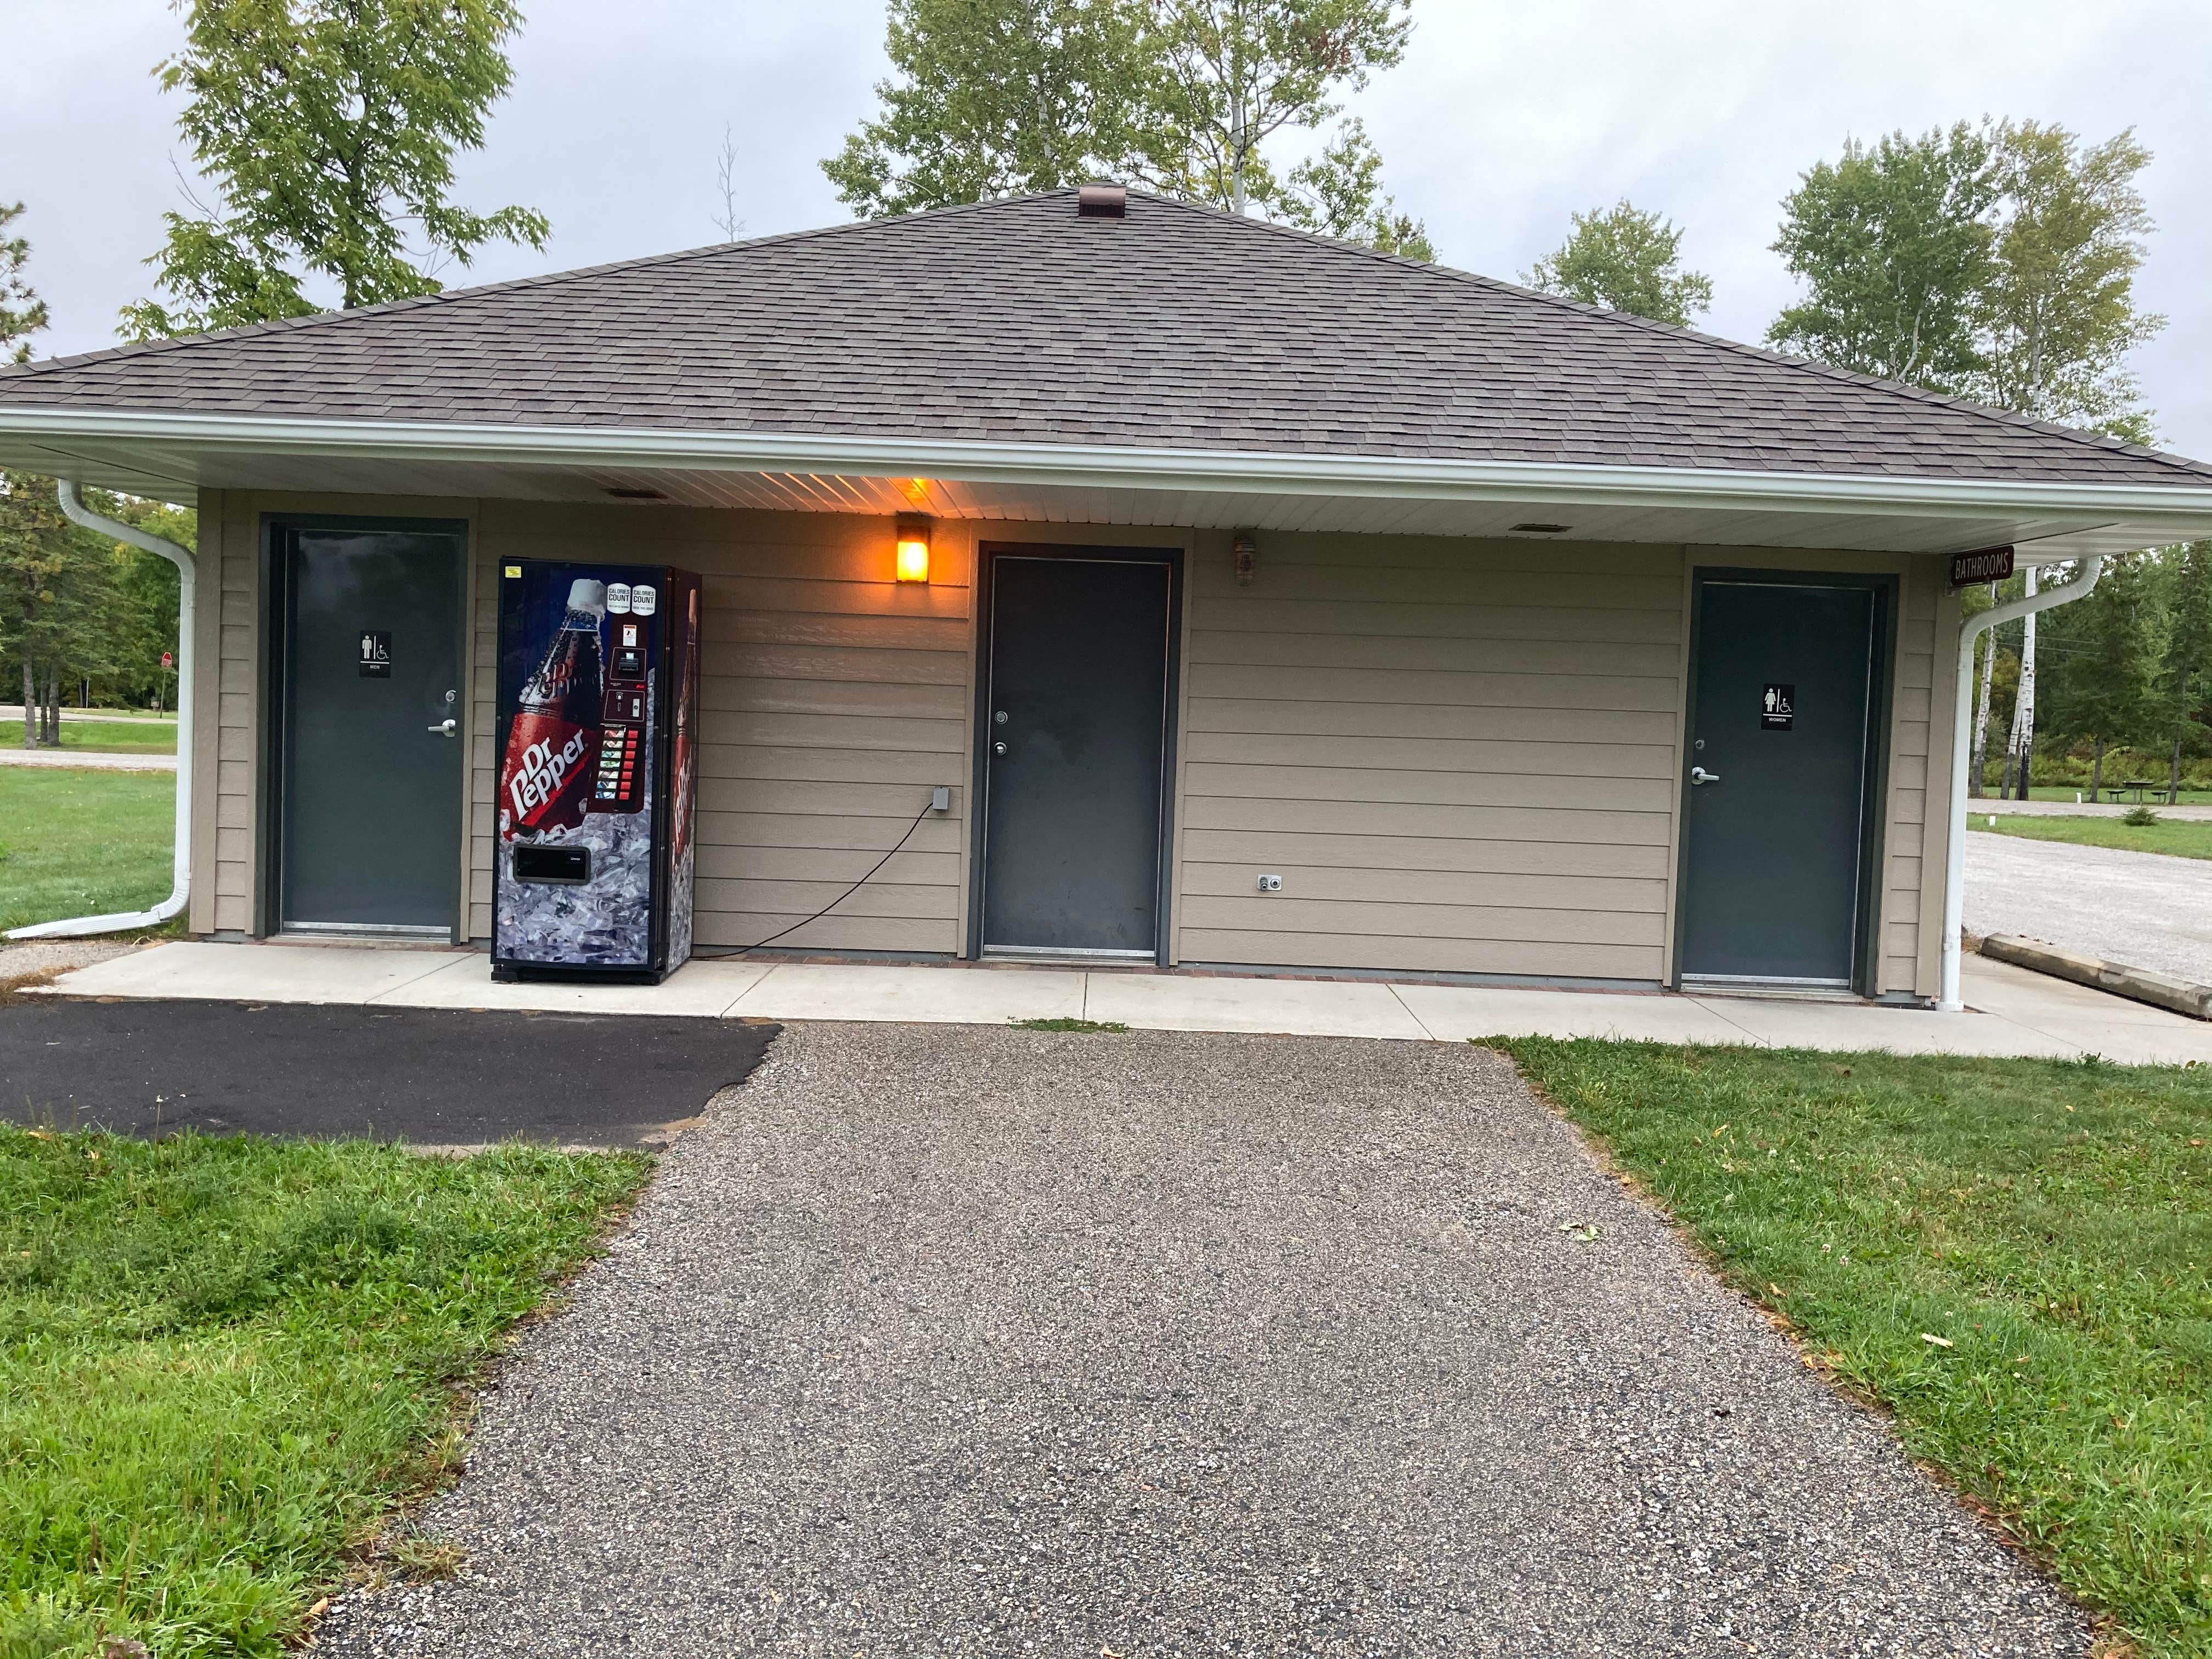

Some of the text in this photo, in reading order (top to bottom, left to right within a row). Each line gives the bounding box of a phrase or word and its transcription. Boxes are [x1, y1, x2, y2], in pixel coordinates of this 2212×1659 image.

[1955, 552, 2008, 579] BATHROOMS
[509, 729, 584, 821] Pepper
[522, 737, 552, 781] Dr
